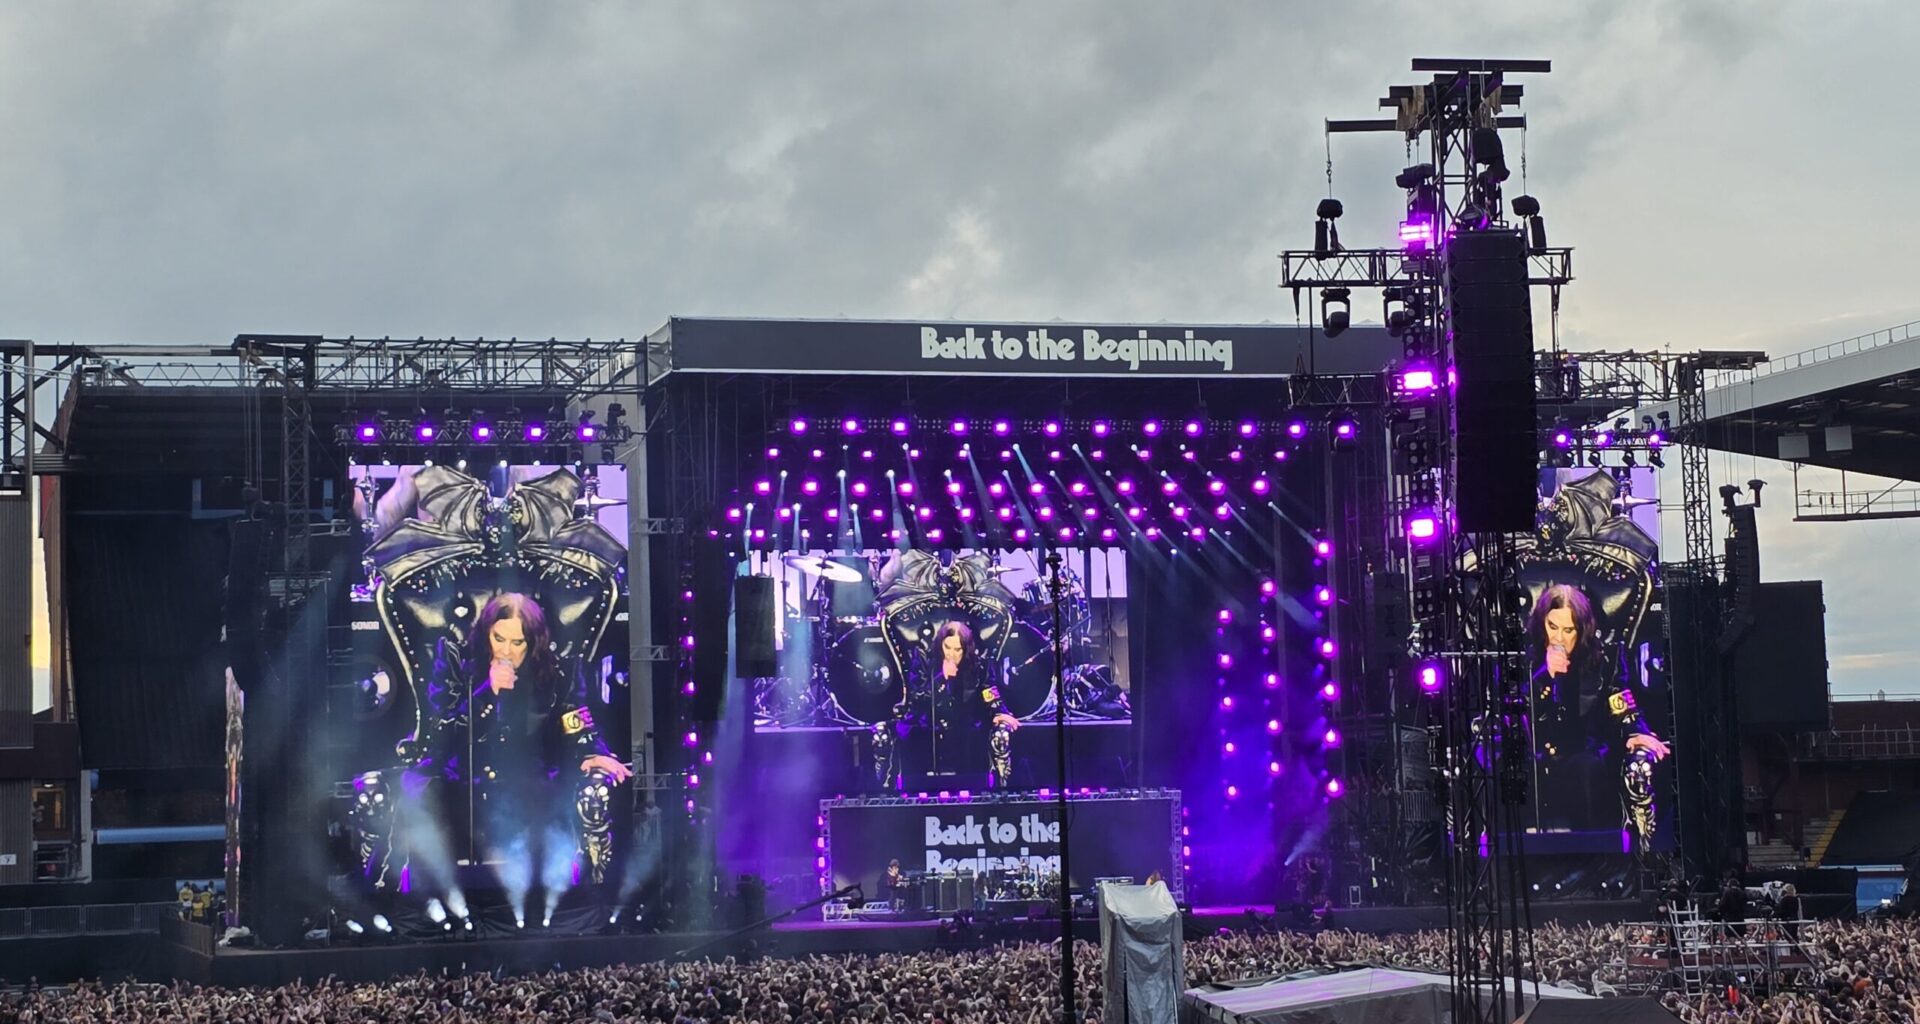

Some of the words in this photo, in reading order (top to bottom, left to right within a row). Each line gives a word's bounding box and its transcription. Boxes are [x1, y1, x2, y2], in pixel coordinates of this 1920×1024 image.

[921, 326, 986, 359] Back
[991, 330, 1023, 360] to
[1028, 328, 1075, 361] the
[1082, 329, 1233, 370] Beginning
[925, 815, 984, 846] Back
[988, 816, 1017, 844] to
[1020, 813, 1061, 843] the
